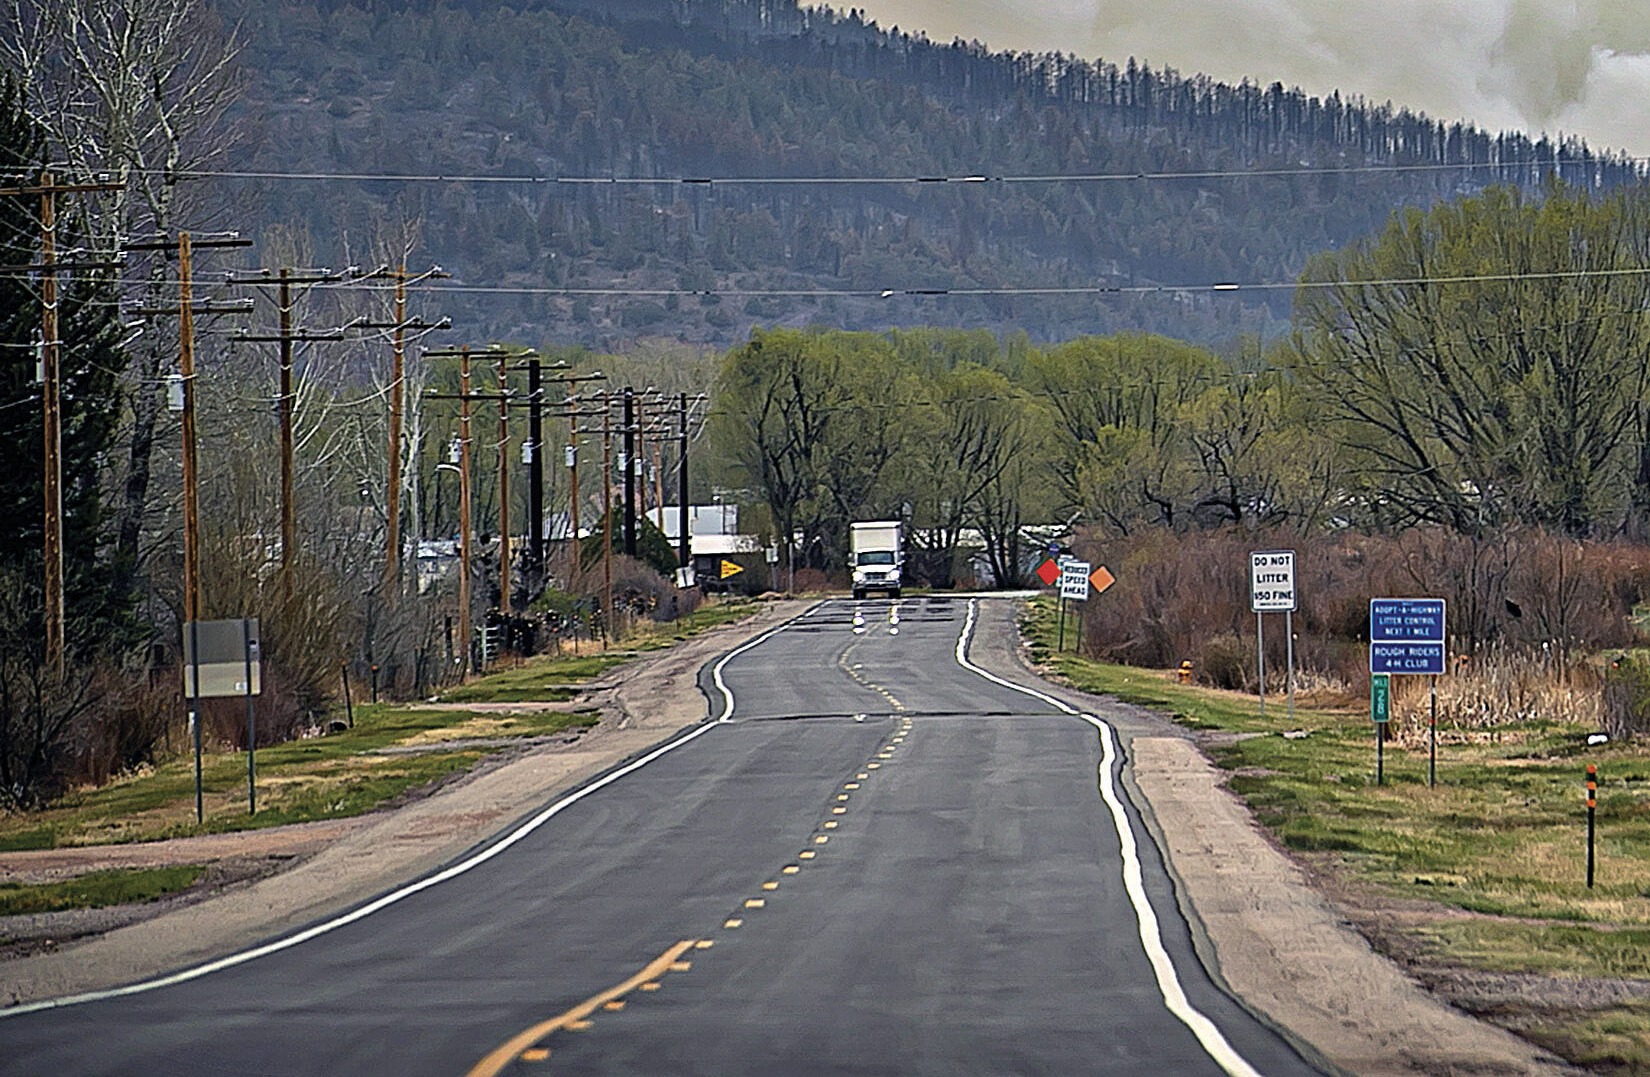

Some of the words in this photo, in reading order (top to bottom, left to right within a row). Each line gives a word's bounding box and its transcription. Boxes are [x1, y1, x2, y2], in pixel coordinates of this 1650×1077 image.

[1254, 556, 1267, 566] DO
[1271, 555, 1290, 566] NOT
[1256, 573, 1289, 583] LITTER
[1272, 590, 1293, 600] FINE
[1374, 647, 1405, 656] ROUGH
[1408, 647, 1440, 657] RIDERS
[1404, 659, 1428, 668] CLUB
